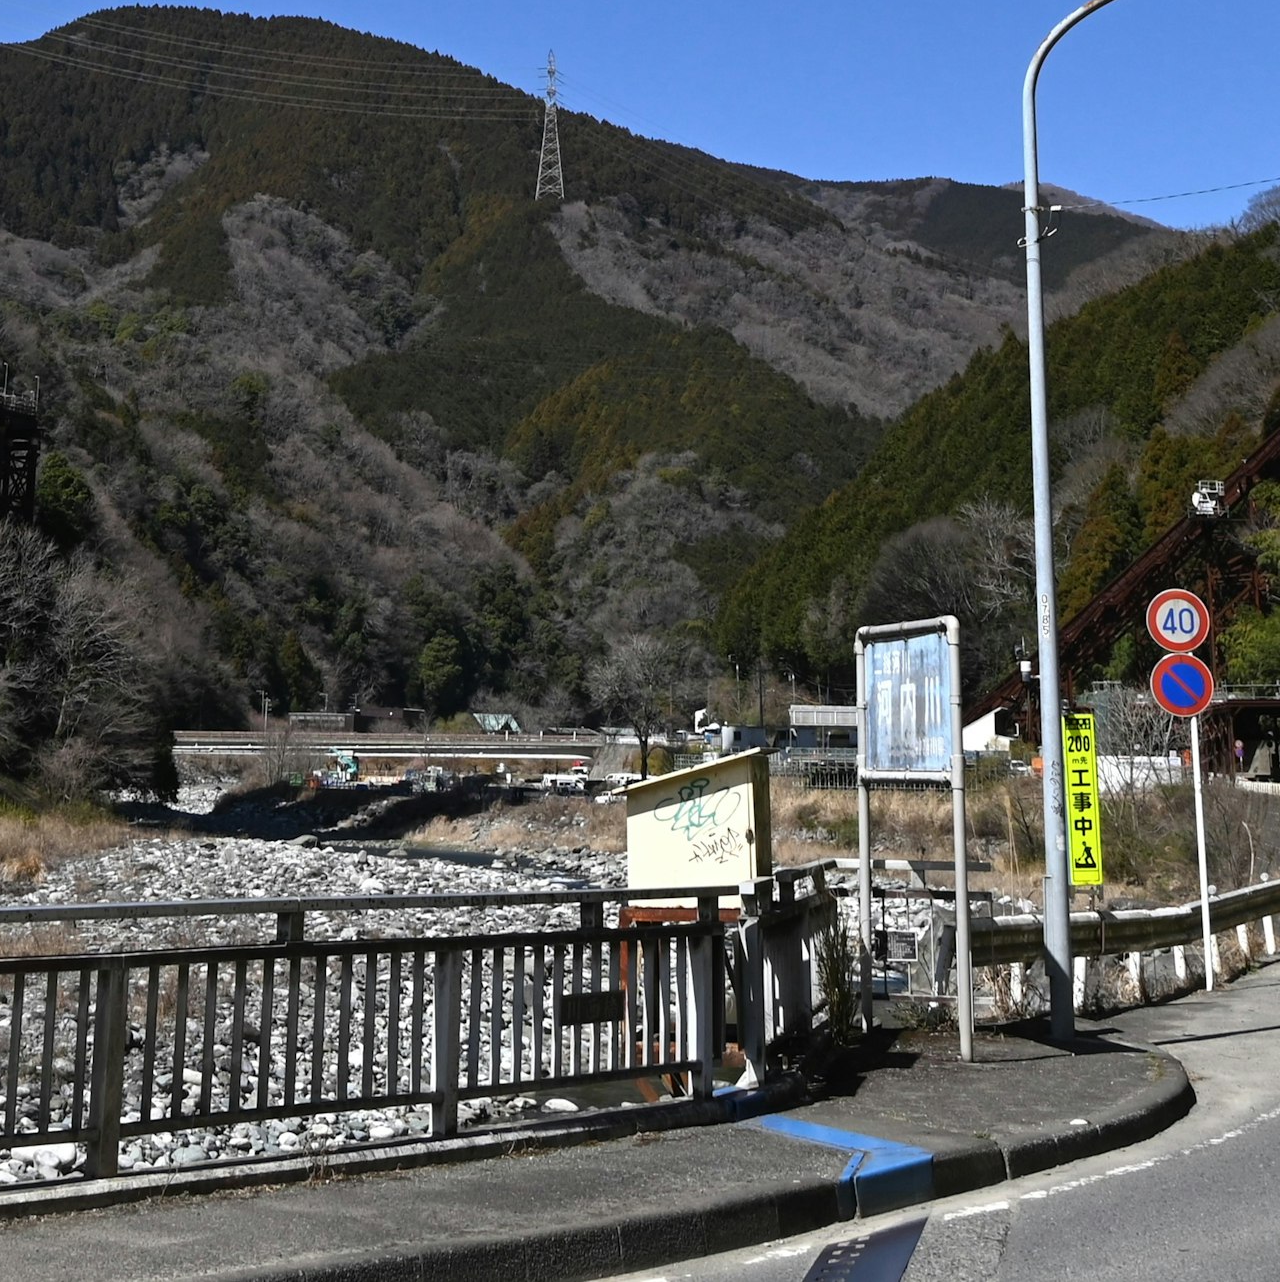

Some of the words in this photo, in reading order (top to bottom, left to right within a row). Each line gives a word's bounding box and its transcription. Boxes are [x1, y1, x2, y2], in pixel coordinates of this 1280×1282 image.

[1162, 607, 1195, 635] 40
[876, 675, 942, 738] 河内川
[1067, 735, 1090, 753] 200
[1072, 756, 1088, 765] m先
[1072, 769, 1092, 836] 工事中
